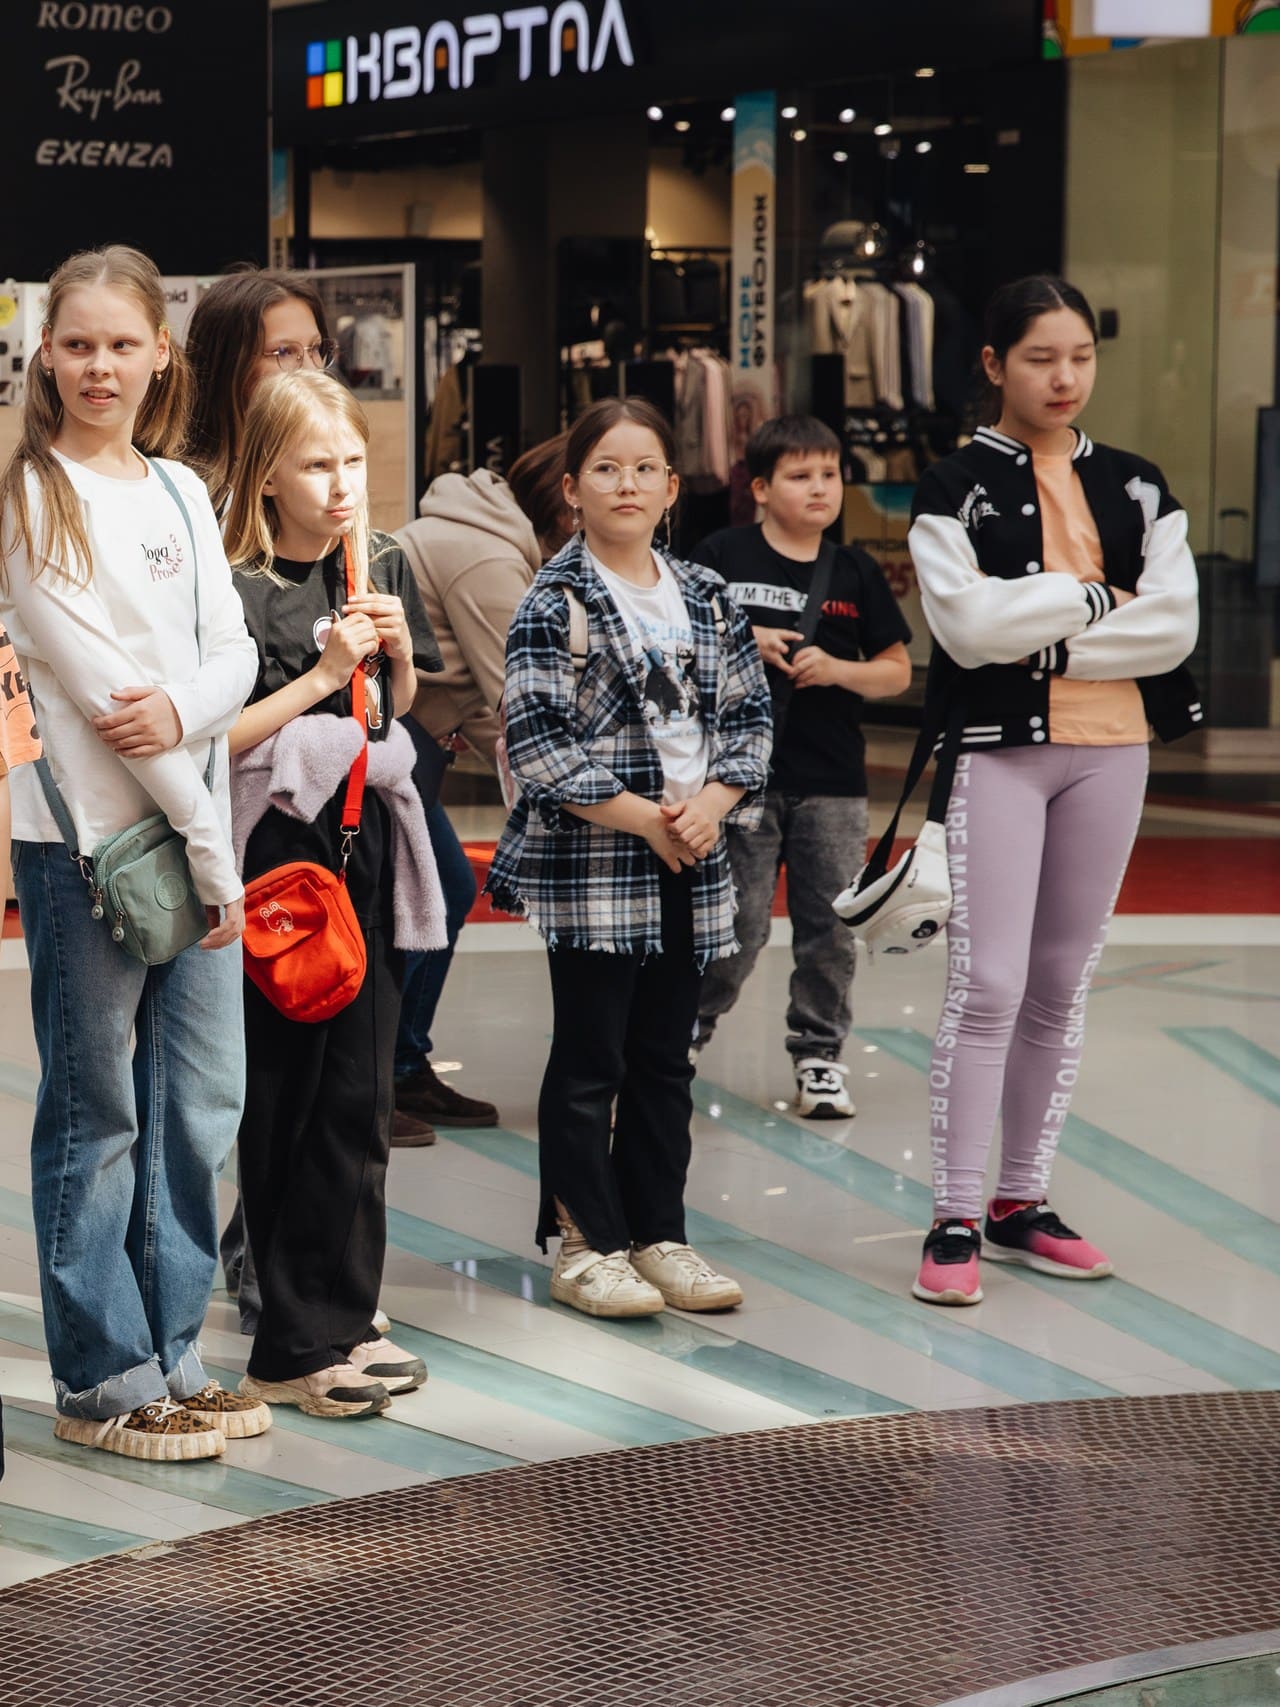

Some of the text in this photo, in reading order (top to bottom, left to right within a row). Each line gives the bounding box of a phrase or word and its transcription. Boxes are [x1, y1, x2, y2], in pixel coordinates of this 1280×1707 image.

[347, 0, 634, 105] КВАРТАЛ
[36, 139, 173, 168] EXENZA
[761, 588, 793, 608] THE
[934, 936, 972, 1049] REASONS
[929, 1054, 955, 1090] TO
[929, 1096, 949, 1131] BE
[1043, 1092, 1073, 1123] BE
